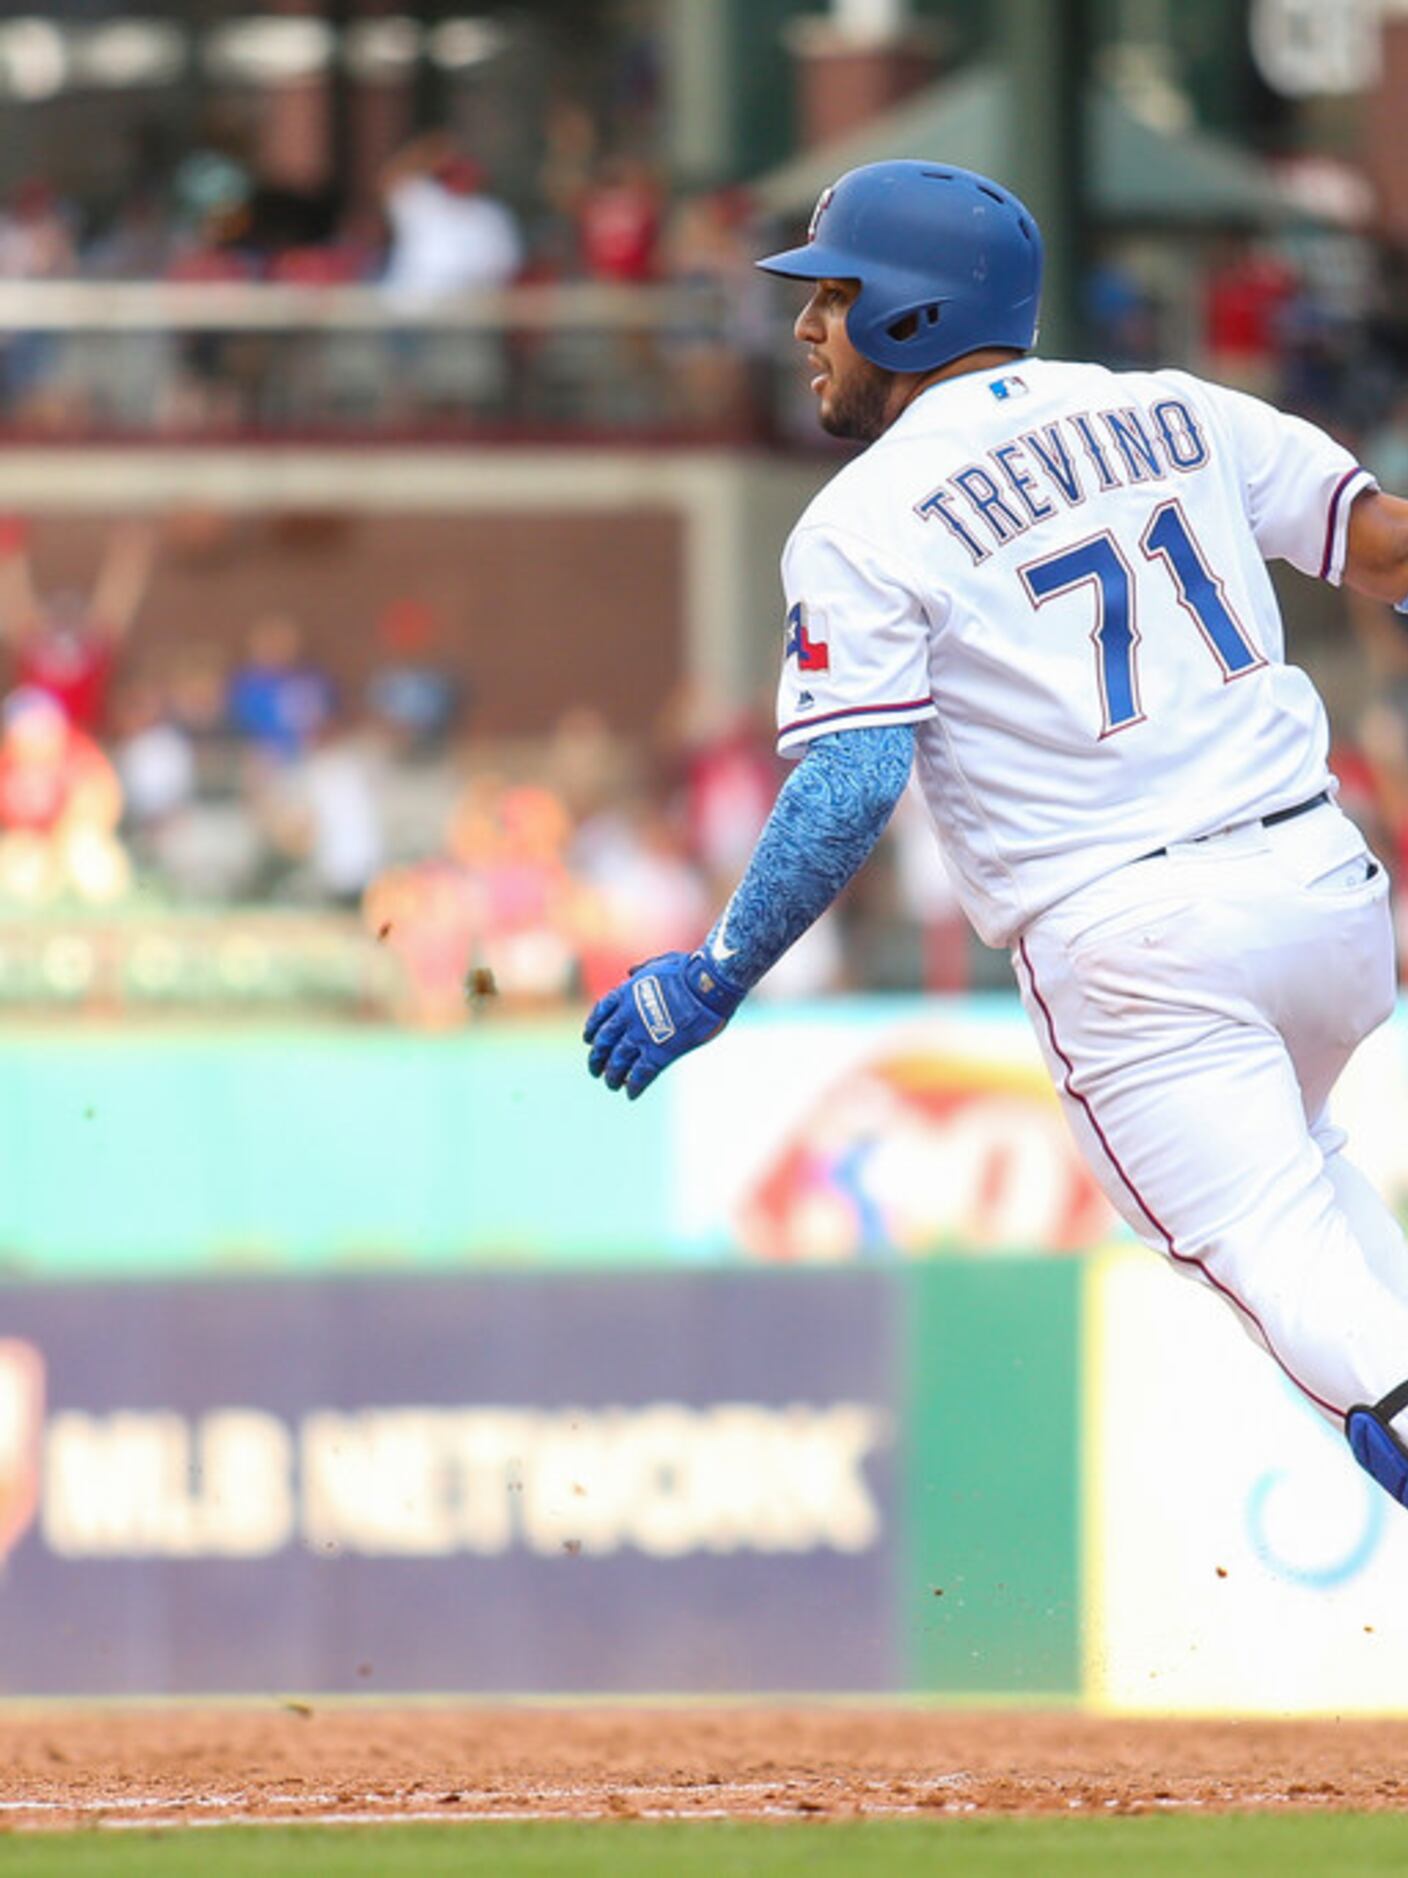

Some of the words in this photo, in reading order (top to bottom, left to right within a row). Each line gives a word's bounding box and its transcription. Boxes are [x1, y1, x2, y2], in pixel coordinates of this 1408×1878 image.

[913, 400, 1211, 567] TREVINO
[1017, 497, 1270, 741] 71
[42, 1407, 294, 1557] MLB
